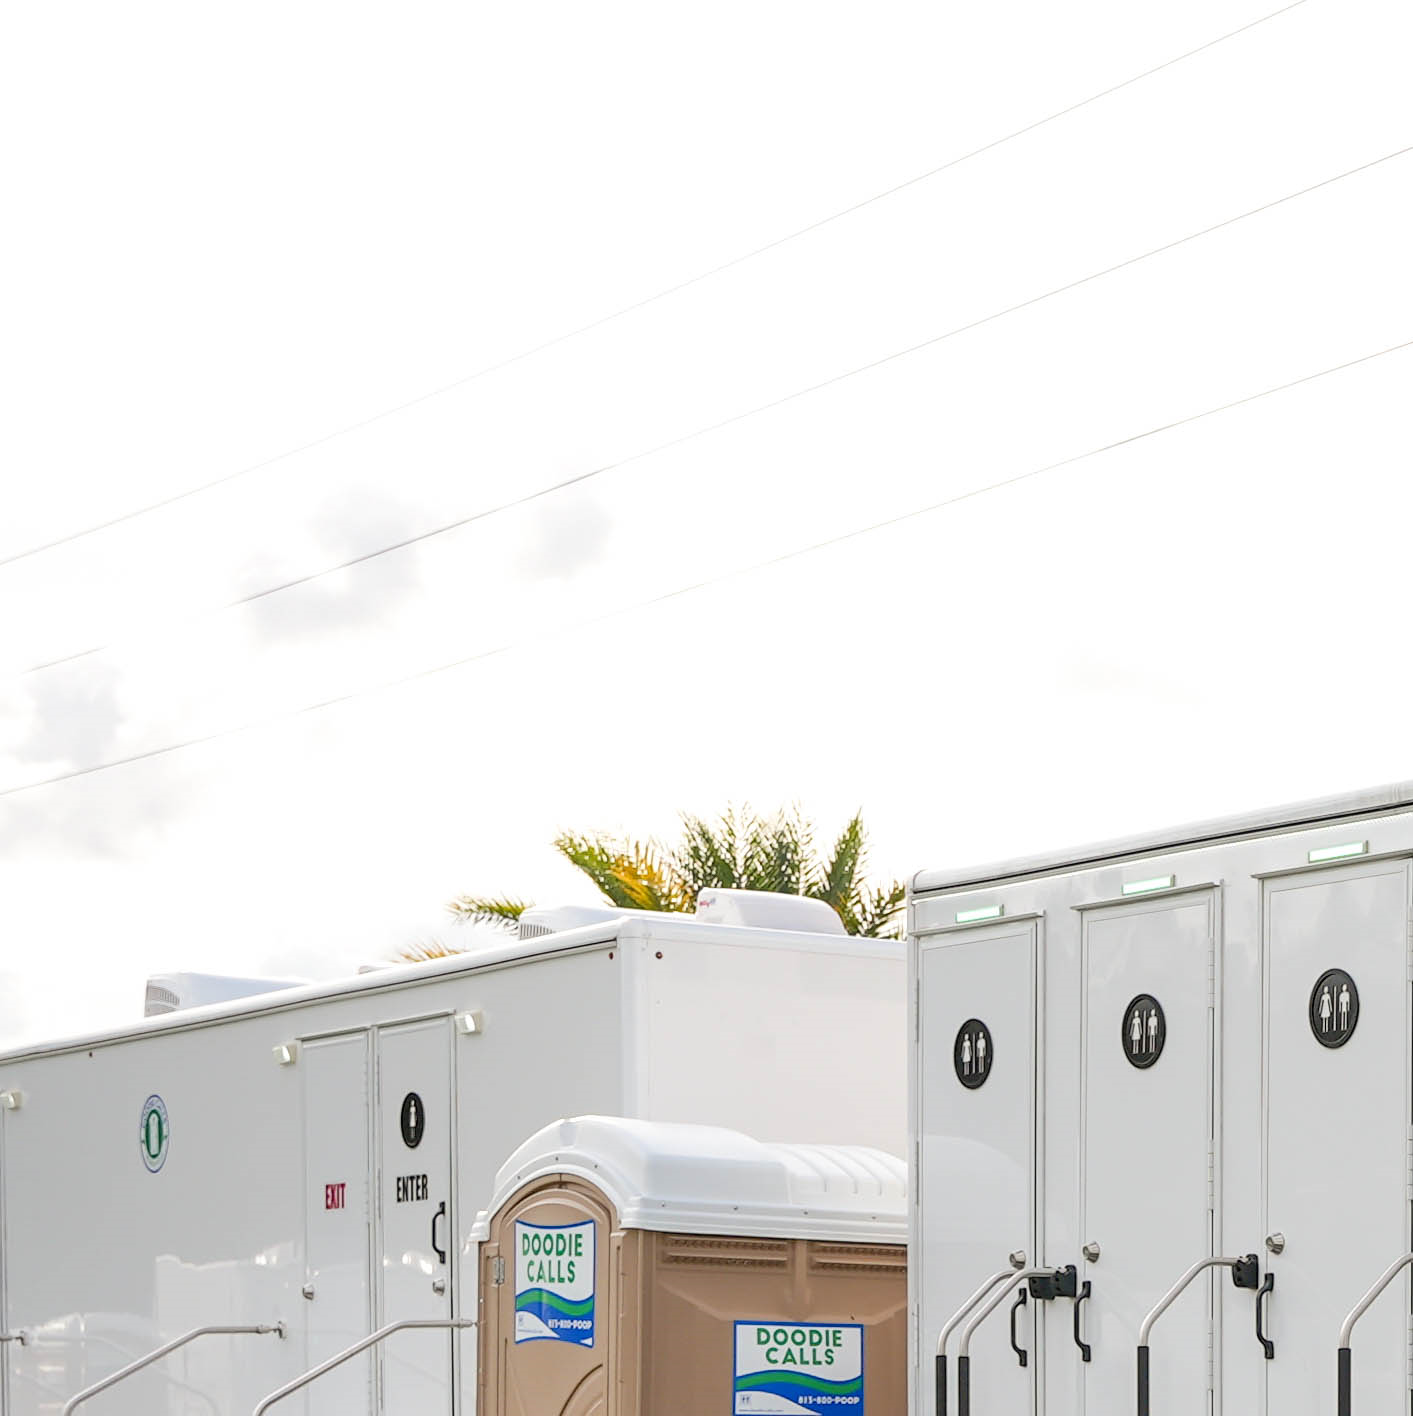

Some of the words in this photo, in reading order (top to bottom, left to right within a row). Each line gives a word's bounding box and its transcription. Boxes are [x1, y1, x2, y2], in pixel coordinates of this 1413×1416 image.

[325, 1183, 346, 1210] EXIT
[396, 1174, 429, 1203] ENTER
[522, 1232, 584, 1257] DOODIE
[527, 1259, 577, 1284] CALLS
[756, 1327, 843, 1348] DOODIE
[765, 1347, 835, 1366] CALLS
